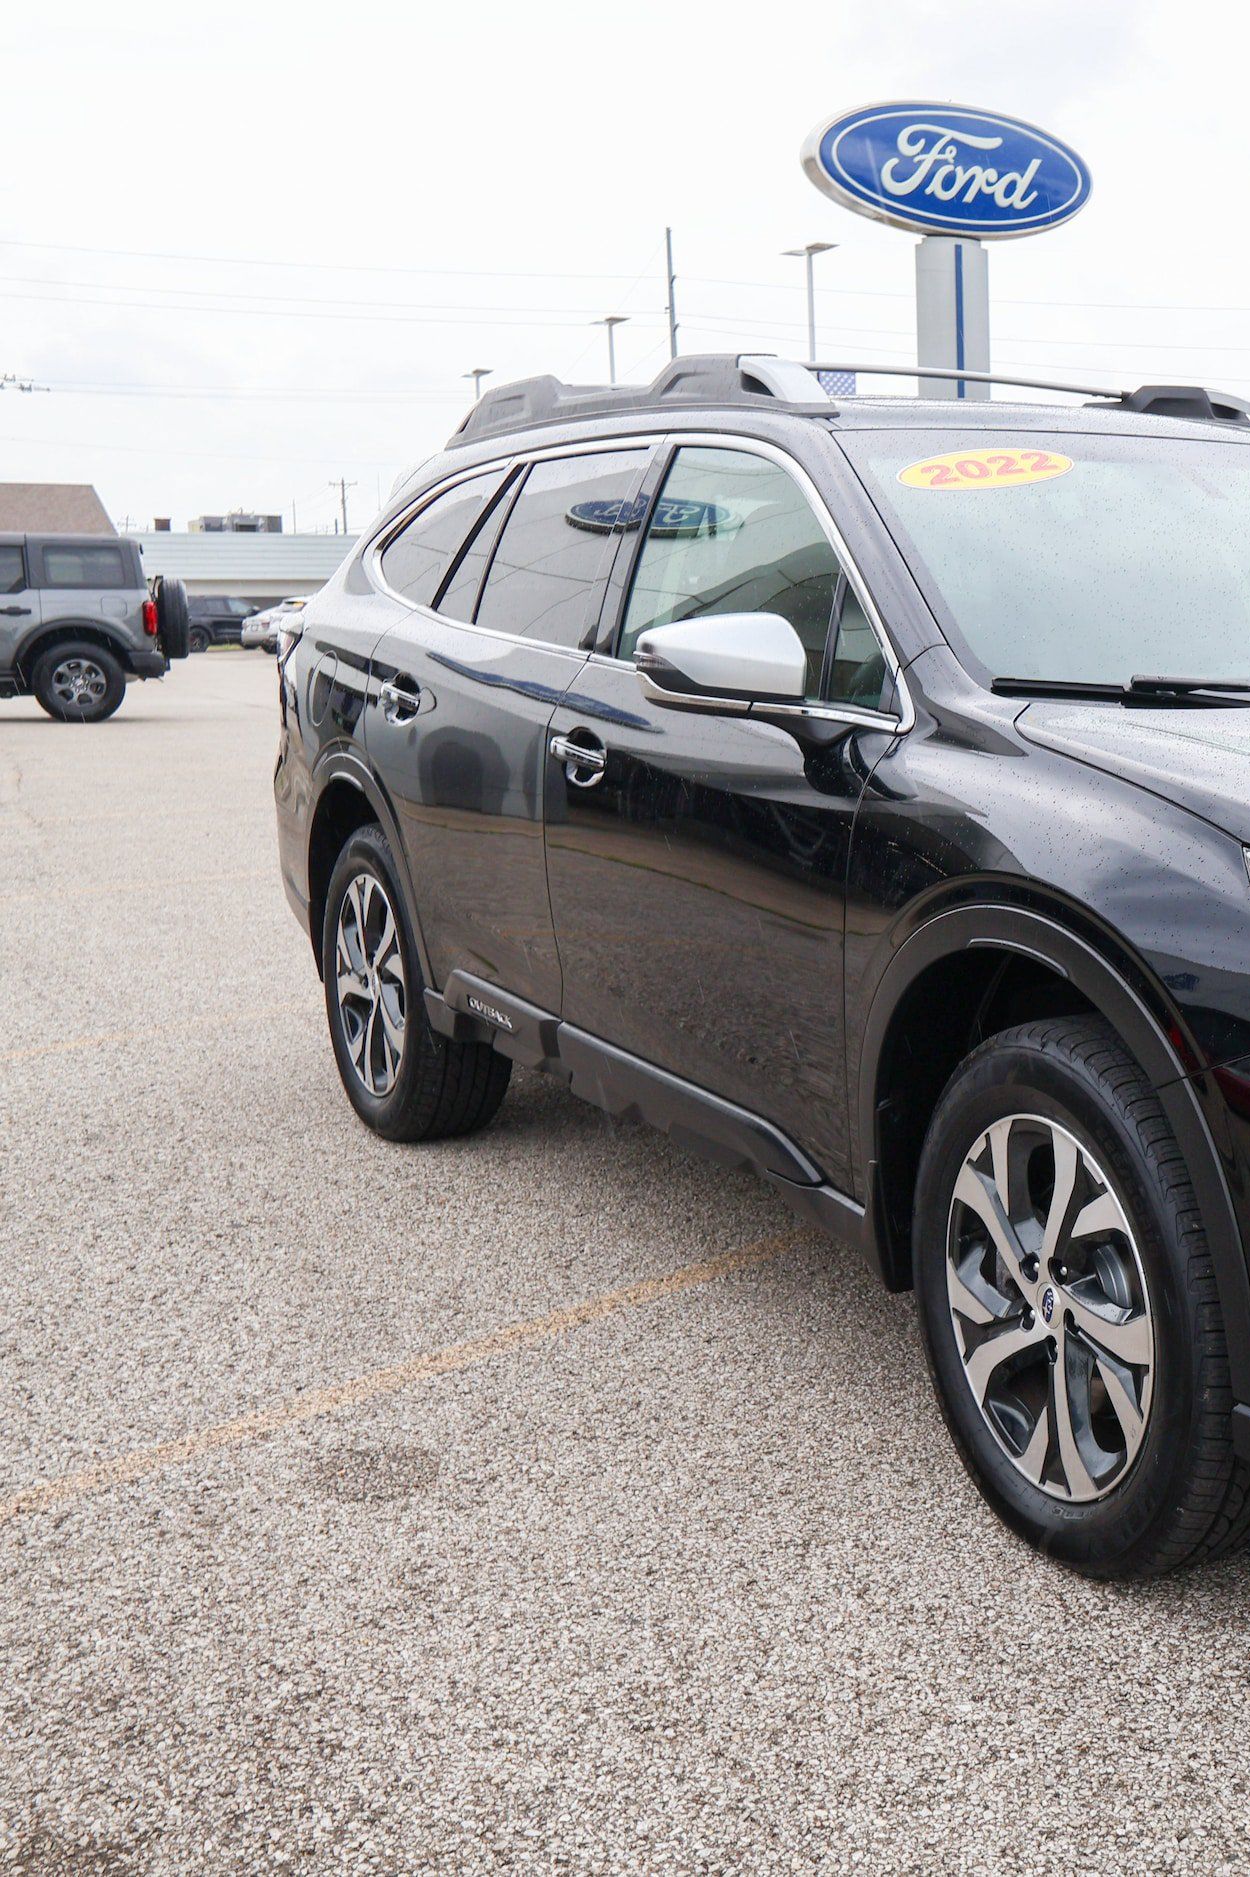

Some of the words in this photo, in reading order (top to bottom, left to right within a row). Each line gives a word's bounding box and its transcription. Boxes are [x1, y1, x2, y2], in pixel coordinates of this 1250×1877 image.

[881, 124, 1042, 210] Ford
[920, 452, 1059, 486] 2022
[468, 997, 512, 1029] OUTBACK
